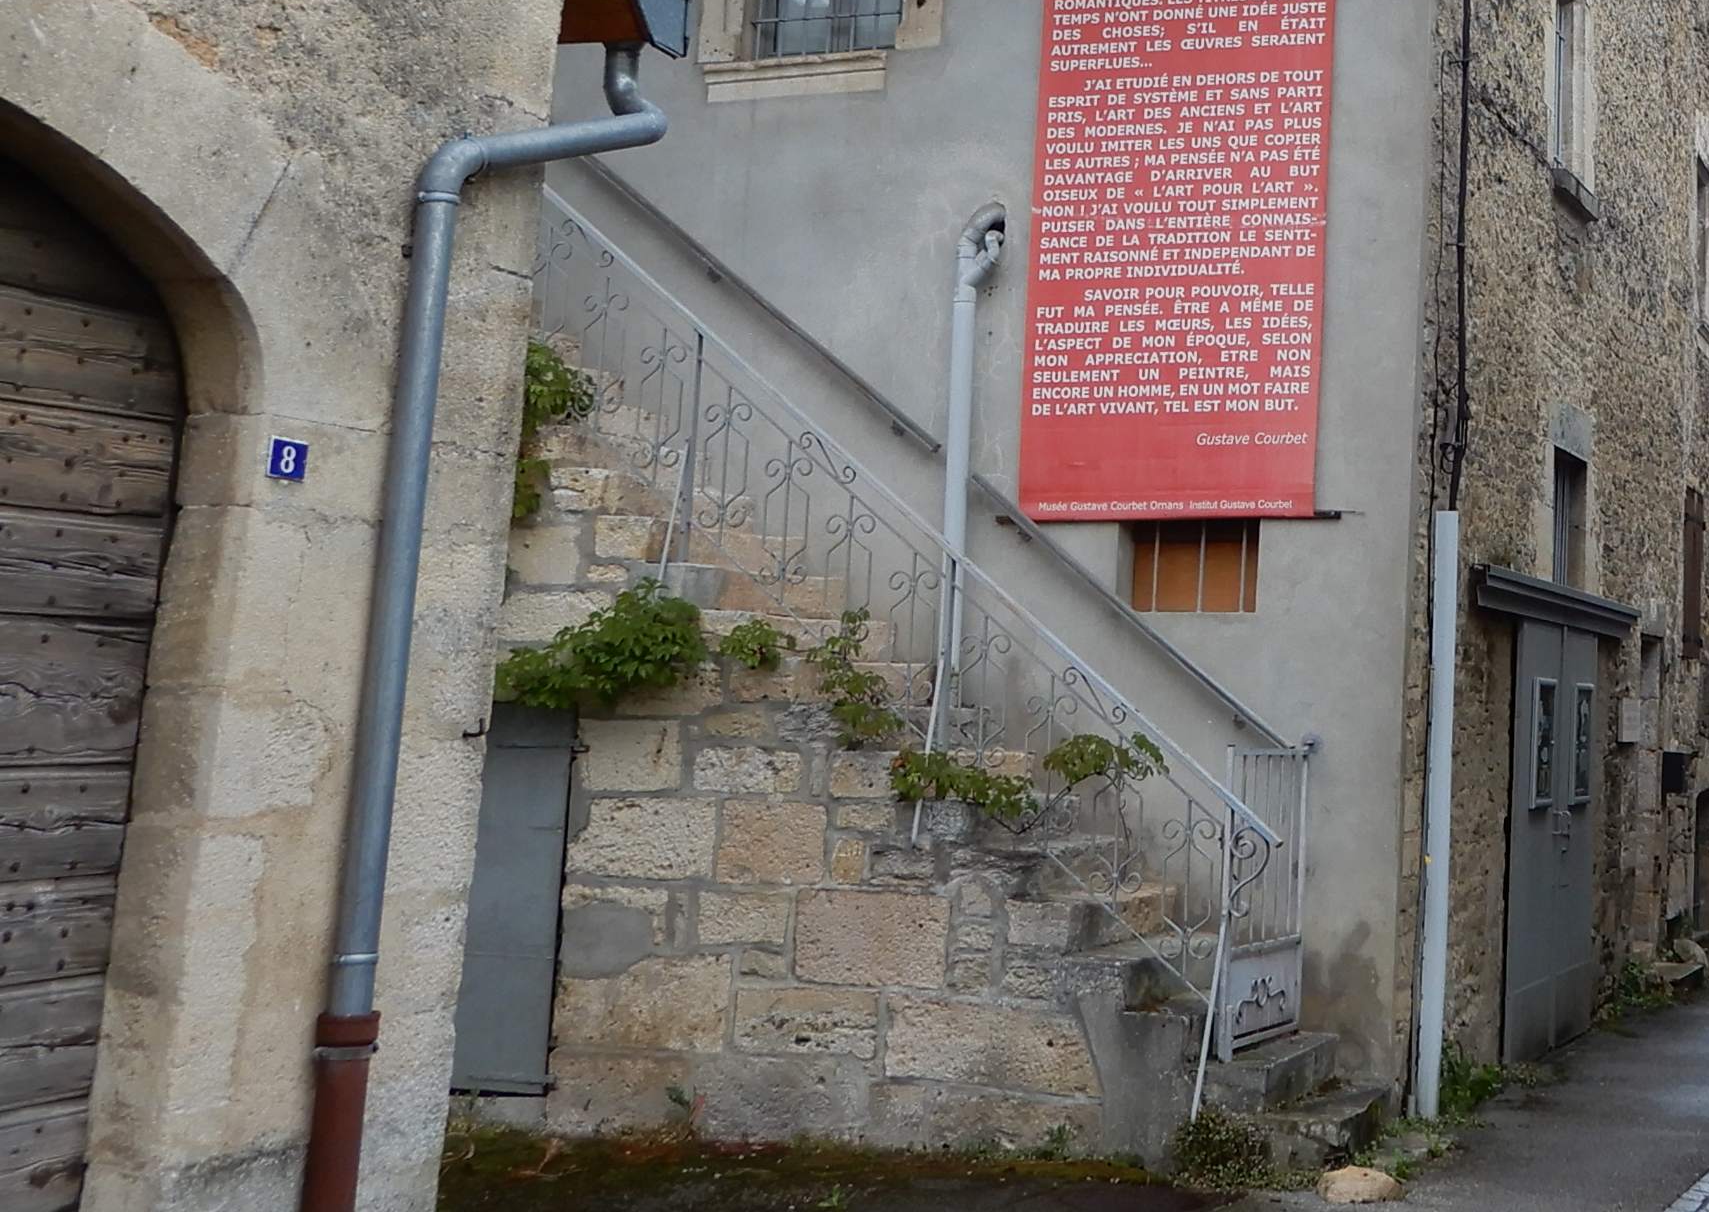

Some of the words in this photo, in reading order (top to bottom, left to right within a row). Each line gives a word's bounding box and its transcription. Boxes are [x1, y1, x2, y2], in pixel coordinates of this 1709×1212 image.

[1053, 12, 1099, 25] TEMPS
[1153, 4, 1203, 20] DONNÉ
[1208, 5, 1237, 17] UNE
[1242, 1, 1276, 16] IDÉE
[1281, 2, 1326, 14] JUSTE
[1051, 41, 1137, 55] AUTREMENT
[1146, 39, 1171, 51] LES
[1251, 33, 1325, 46] SERAIENT
[1049, 94, 1100, 107] ESPRIT
[1107, 93, 1125, 105] DE
[1133, 88, 1197, 104] SYSTÈME
[1206, 89, 1223, 100] ET
[1230, 87, 1269, 99] SANS
[1277, 85, 1322, 97] PARTI
[1048, 111, 1086, 123] PRIS,
[1144, 106, 1171, 119] DES
[1179, 104, 1244, 117] ANCIENS
[1254, 103, 1271, 114] ET
[1047, 127, 1074, 138] DES
[1084, 123, 1166, 137] MODERNES.
[1177, 121, 1193, 133] JE
[1245, 118, 1273, 130] PAS
[1284, 117, 1321, 129] PLUS
[1046, 142, 1094, 154] VOULU
[1100, 139, 1152, 152] IMITER
[1159, 138, 1184, 149] LES
[1191, 136, 1220, 148] UNS
[1227, 134, 1257, 149] QUE
[1265, 133, 1320, 145] COPIER
[1044, 171, 1132, 185] DAVANTAGE
[1250, 166, 1270, 177] AU
[1289, 164, 1319, 176] BUT
[1040, 236, 1087, 248] SANCE
[1096, 235, 1113, 246] DE
[1122, 234, 1139, 245] LA
[1148, 231, 1231, 244] TRADITION
[1239, 230, 1255, 241] LE
[1264, 229, 1316, 241] SENTI-
[1040, 252, 1080, 264] MENT
[1084, 246, 1158, 263] RAISONNÉ
[1163, 249, 1180, 260] ET
[1184, 245, 1291, 259] INDEPENDANT
[1296, 245, 1315, 256] DE
[1039, 269, 1060, 280] MA
[1065, 266, 1121, 279] PROPRE
[1126, 259, 1244, 277] INDIVIDUALITÉ.
[1084, 288, 1139, 301] SAVOIR
[1145, 286, 1184, 298] POUR
[1191, 284, 1263, 297] POUVOIR,
[1270, 283, 1313, 295] TELLE
[1037, 306, 1064, 318] FUT
[1074, 305, 1094, 317] MA
[1105, 300, 1162, 316] PENSÉE.
[1174, 299, 1209, 313] ÊTRE
[1219, 301, 1229, 312] A
[1240, 297, 1282, 312] MÊME
[1294, 299, 1313, 311] DE
[1035, 321, 1109, 334] TRADUIRE
[1120, 320, 1144, 332] LES
[1225, 317, 1251, 328] LES
[1262, 313, 1311, 329] IDÉES,
[1112, 336, 1131, 348] DE
[1142, 335, 1174, 347] MON
[1186, 331, 1249, 348] ÉPOQUE,
[1262, 332, 1311, 344] SELON
[1034, 355, 1067, 366] MON
[1085, 351, 1201, 365] APPRECIATION,
[1220, 349, 1257, 361] ETRE
[1277, 348, 1310, 360] NON
[1033, 369, 1119, 382] SEULEMENT
[1139, 368, 1159, 380] UN
[1179, 366, 1248, 380] PEINTRE,
[1270, 365, 1309, 377] MAIS
[1033, 386, 1089, 399] ENCORE
[1093, 386, 1113, 397] UN
[1118, 384, 1174, 398] HOMME,
[1180, 383, 1198, 395] EN
[1203, 383, 1223, 395] UN
[1228, 382, 1260, 394] MOT
[1264, 382, 1308, 394] FAIRE
[1032, 403, 1050, 415] DE
[1100, 401, 1158, 414] VIVANT,
[1163, 400, 1188, 412] TEL
[1194, 400, 1220, 411] EST
[1225, 399, 1258, 411] MON
[1265, 398, 1297, 410] BUT.
[1196, 432, 1249, 445] Gustave
[1254, 431, 1307, 444] Courbet
[280, 445, 296, 474] 8
[1038, 501, 1067, 511] Musée
[1070, 501, 1108, 511] Gustave
[1110, 501, 1147, 511] Courbet
[1189, 500, 1218, 509] Institut
[1219, 499, 1256, 509] Gustave
[1257, 499, 1292, 509] Courbet
